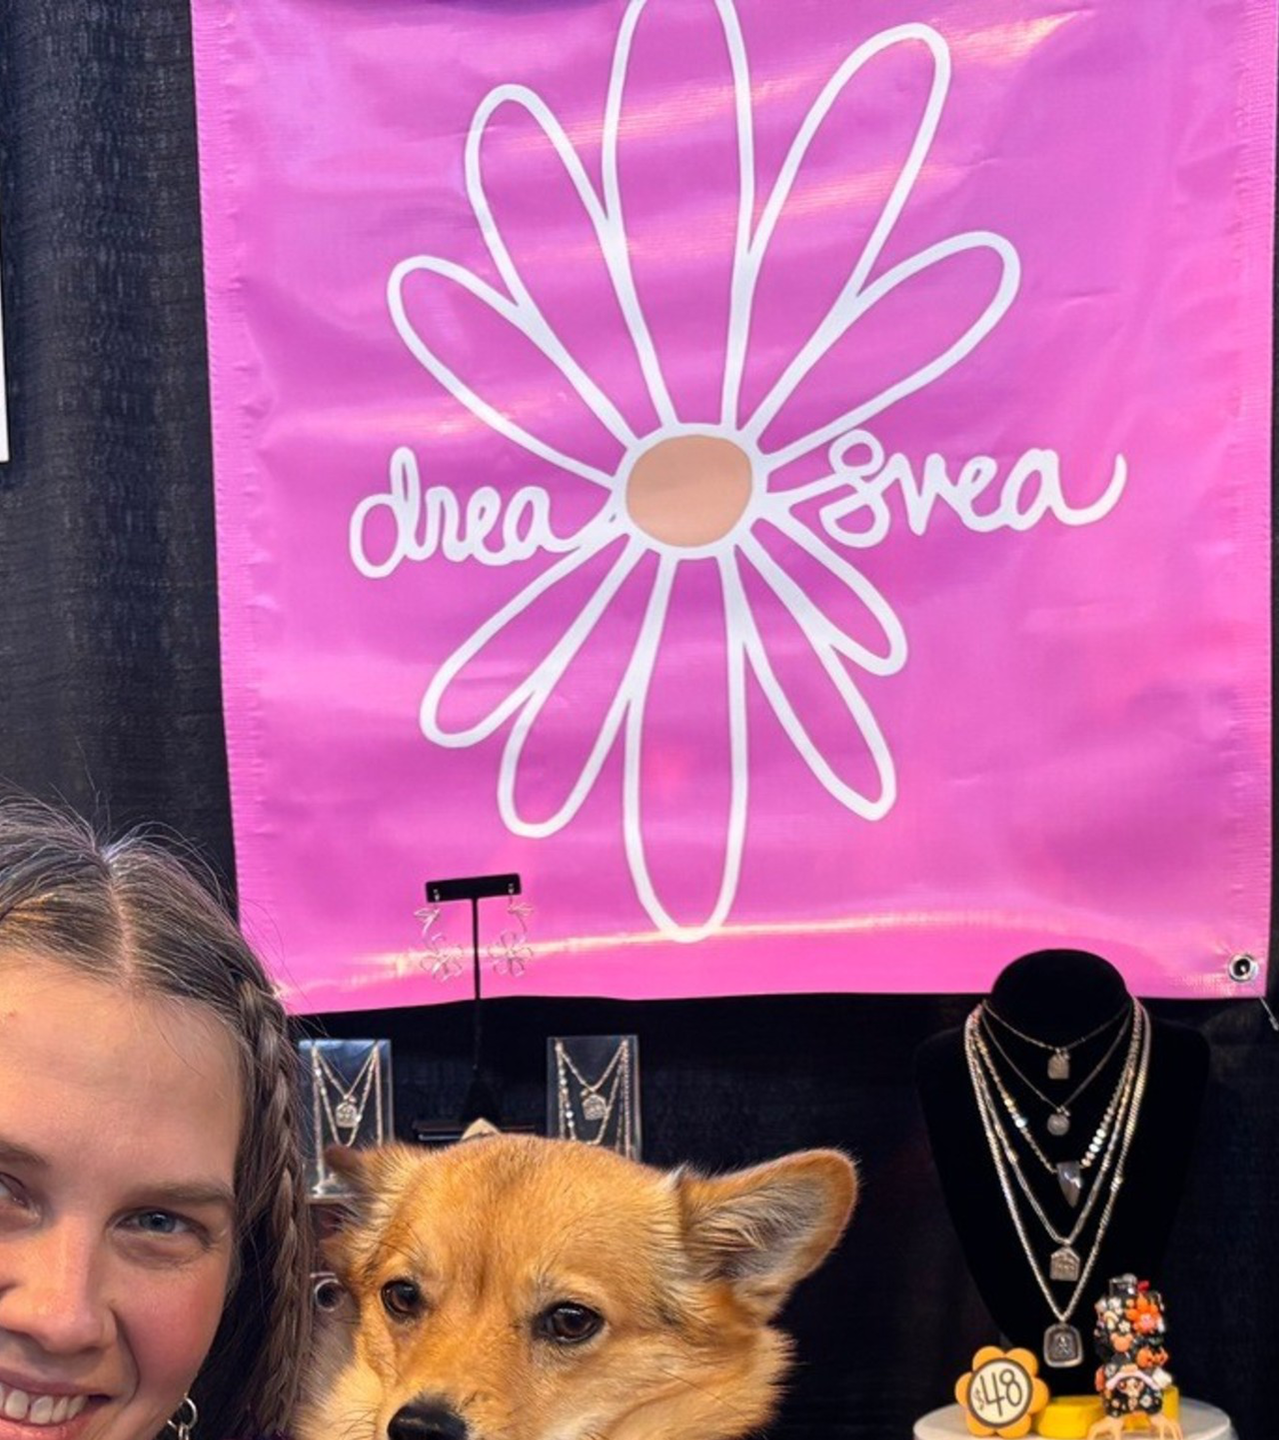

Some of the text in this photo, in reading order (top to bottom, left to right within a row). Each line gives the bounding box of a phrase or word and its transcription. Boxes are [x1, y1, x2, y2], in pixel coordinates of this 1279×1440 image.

[349, 429, 1127, 578] drea svea
[973, 1368, 1022, 1417] $48
